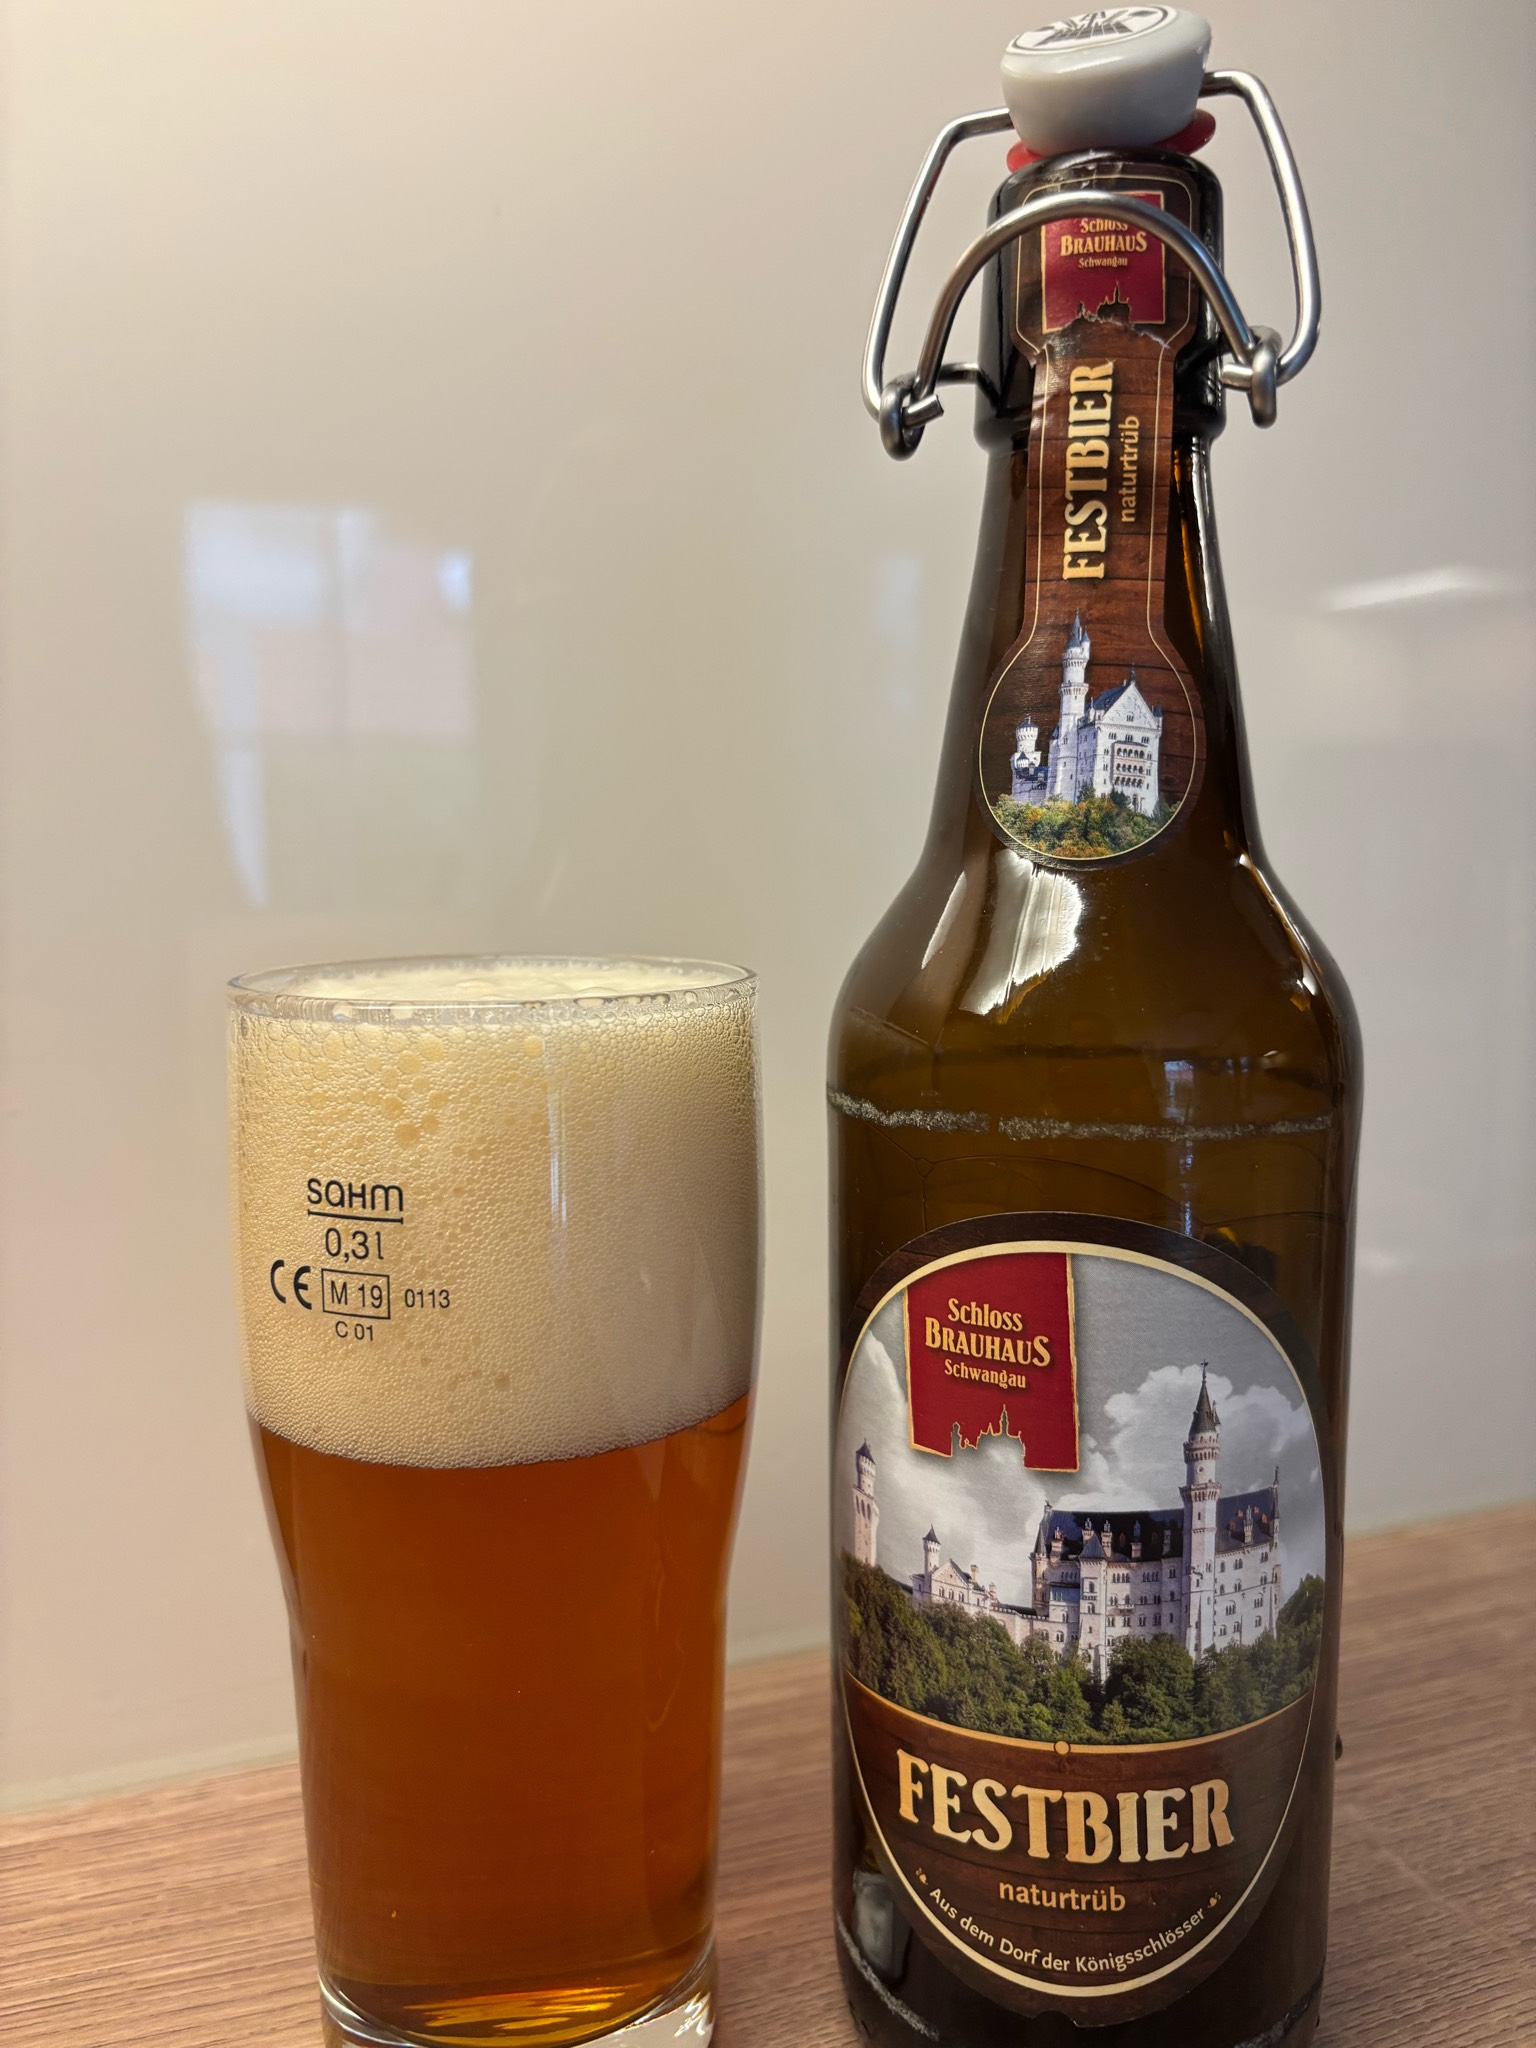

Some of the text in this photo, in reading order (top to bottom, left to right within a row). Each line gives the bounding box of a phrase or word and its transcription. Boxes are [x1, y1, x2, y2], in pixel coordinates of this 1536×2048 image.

[1060, 231, 1147, 256] BRAUHAUS
[1078, 255, 1128, 269] Schwangau
[1062, 361, 1114, 580] FESTBIER
[1118, 415, 1140, 523] naturtrüb
[331, 1280, 348, 1306] M
[358, 1283, 384, 1309] 19
[404, 1288, 450, 1309] 0113
[947, 1297, 1024, 1332] Schloss
[924, 1316, 1052, 1367] BRAUHAUS
[944, 1359, 1027, 1389] Schwangau
[897, 1748, 1235, 1863] FESTBIER
[999, 1880, 1127, 1912] naturtrüb
[929, 1887, 1206, 1973] Aus dem Dorf der Königsschlösser
